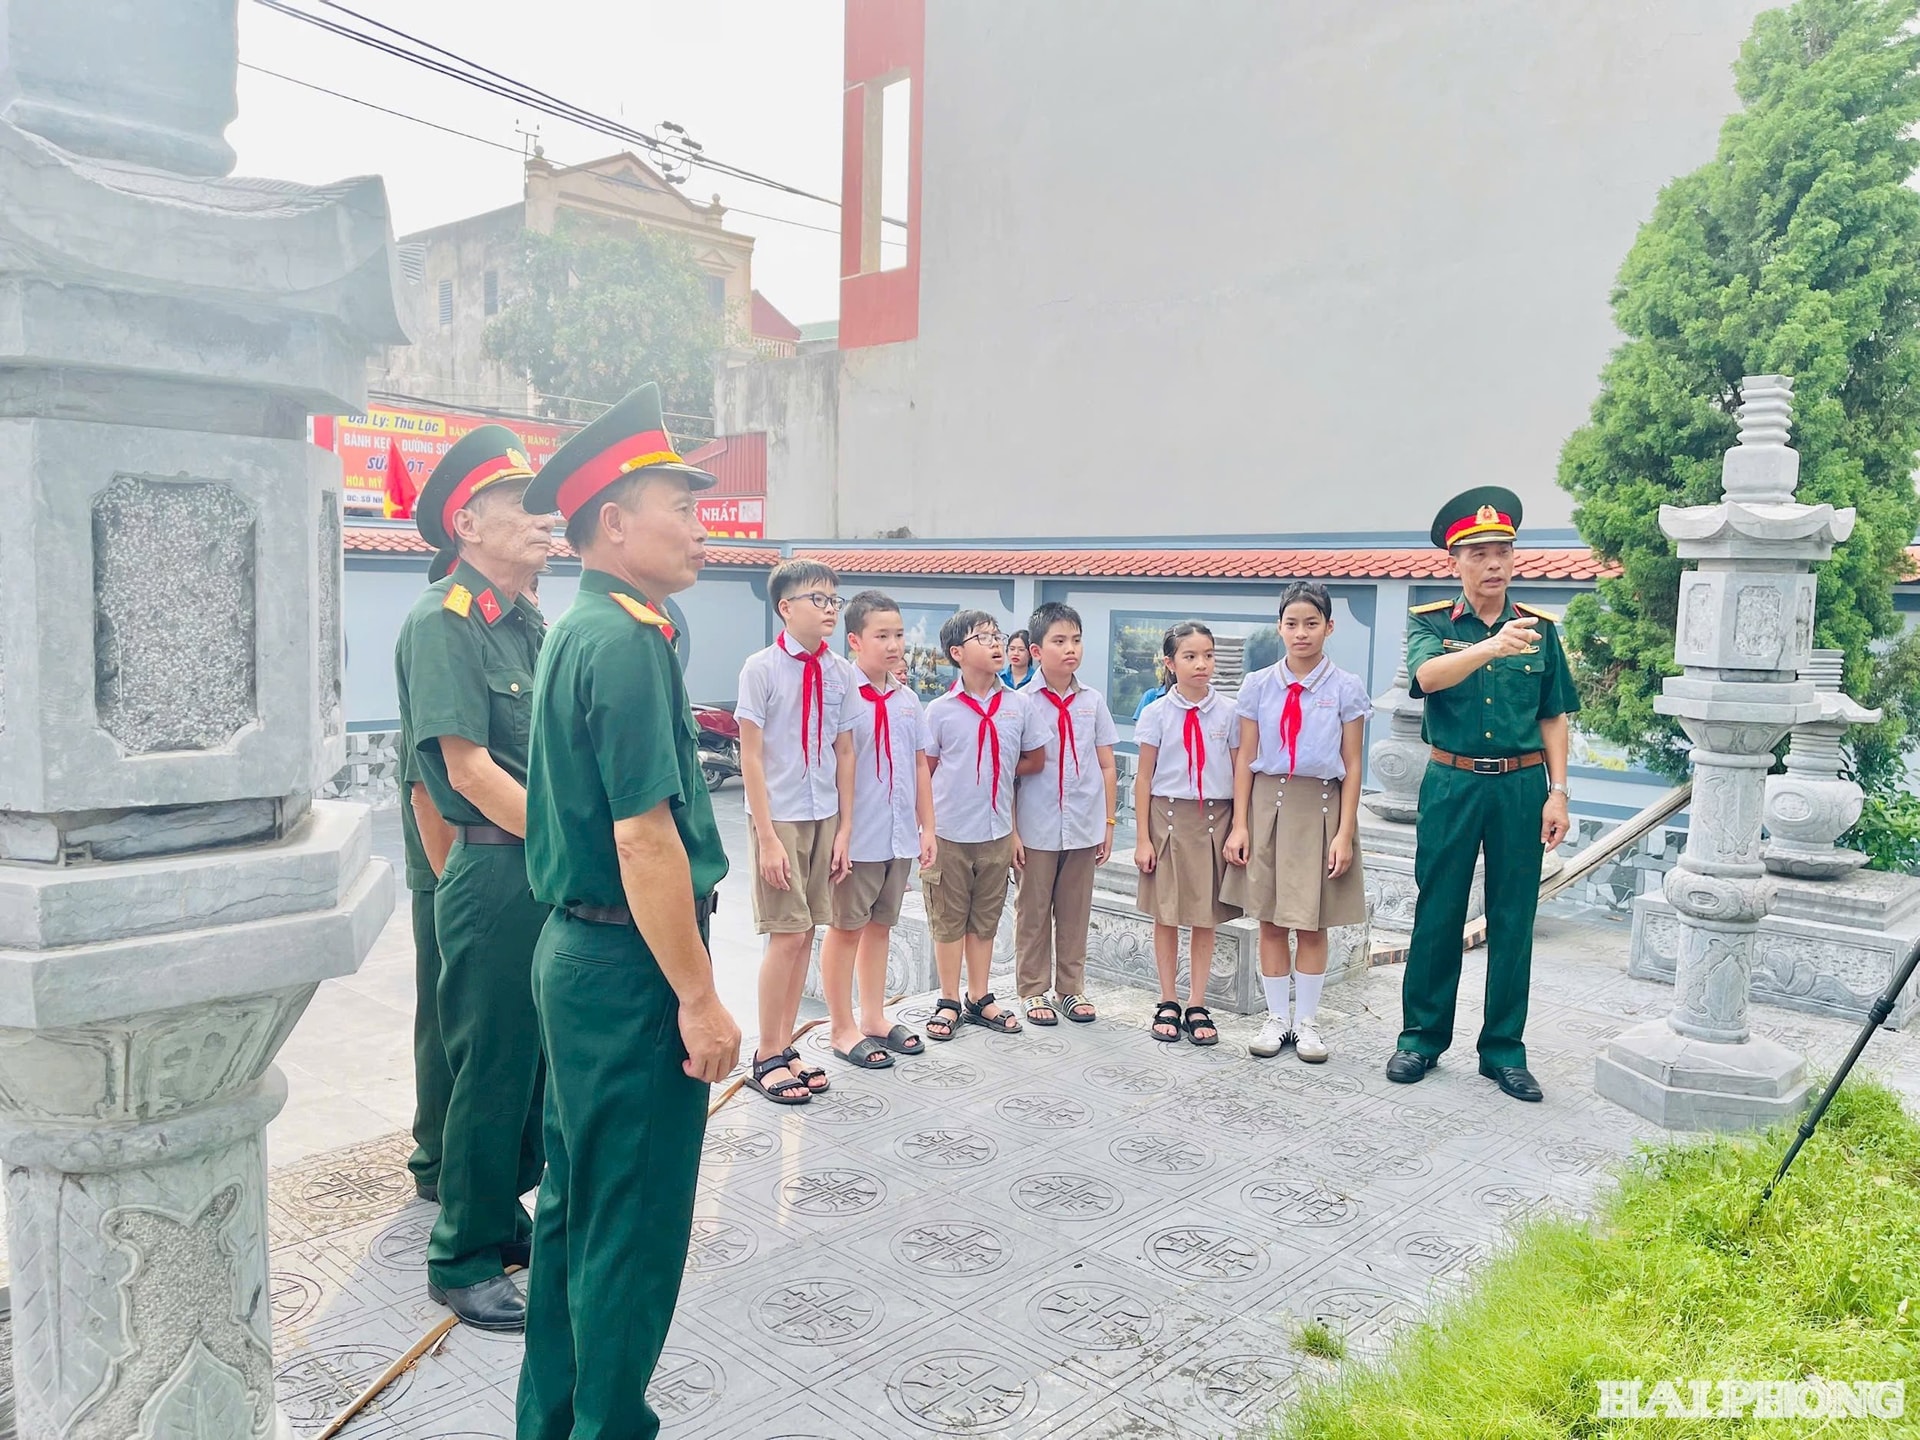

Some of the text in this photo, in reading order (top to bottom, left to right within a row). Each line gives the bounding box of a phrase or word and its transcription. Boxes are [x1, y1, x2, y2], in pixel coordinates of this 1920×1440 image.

[394, 416, 415, 430] Thu
[418, 419, 439, 434] Lộc
[343, 430, 372, 447] BÁNH
[701, 501, 738, 522] NHẤT
